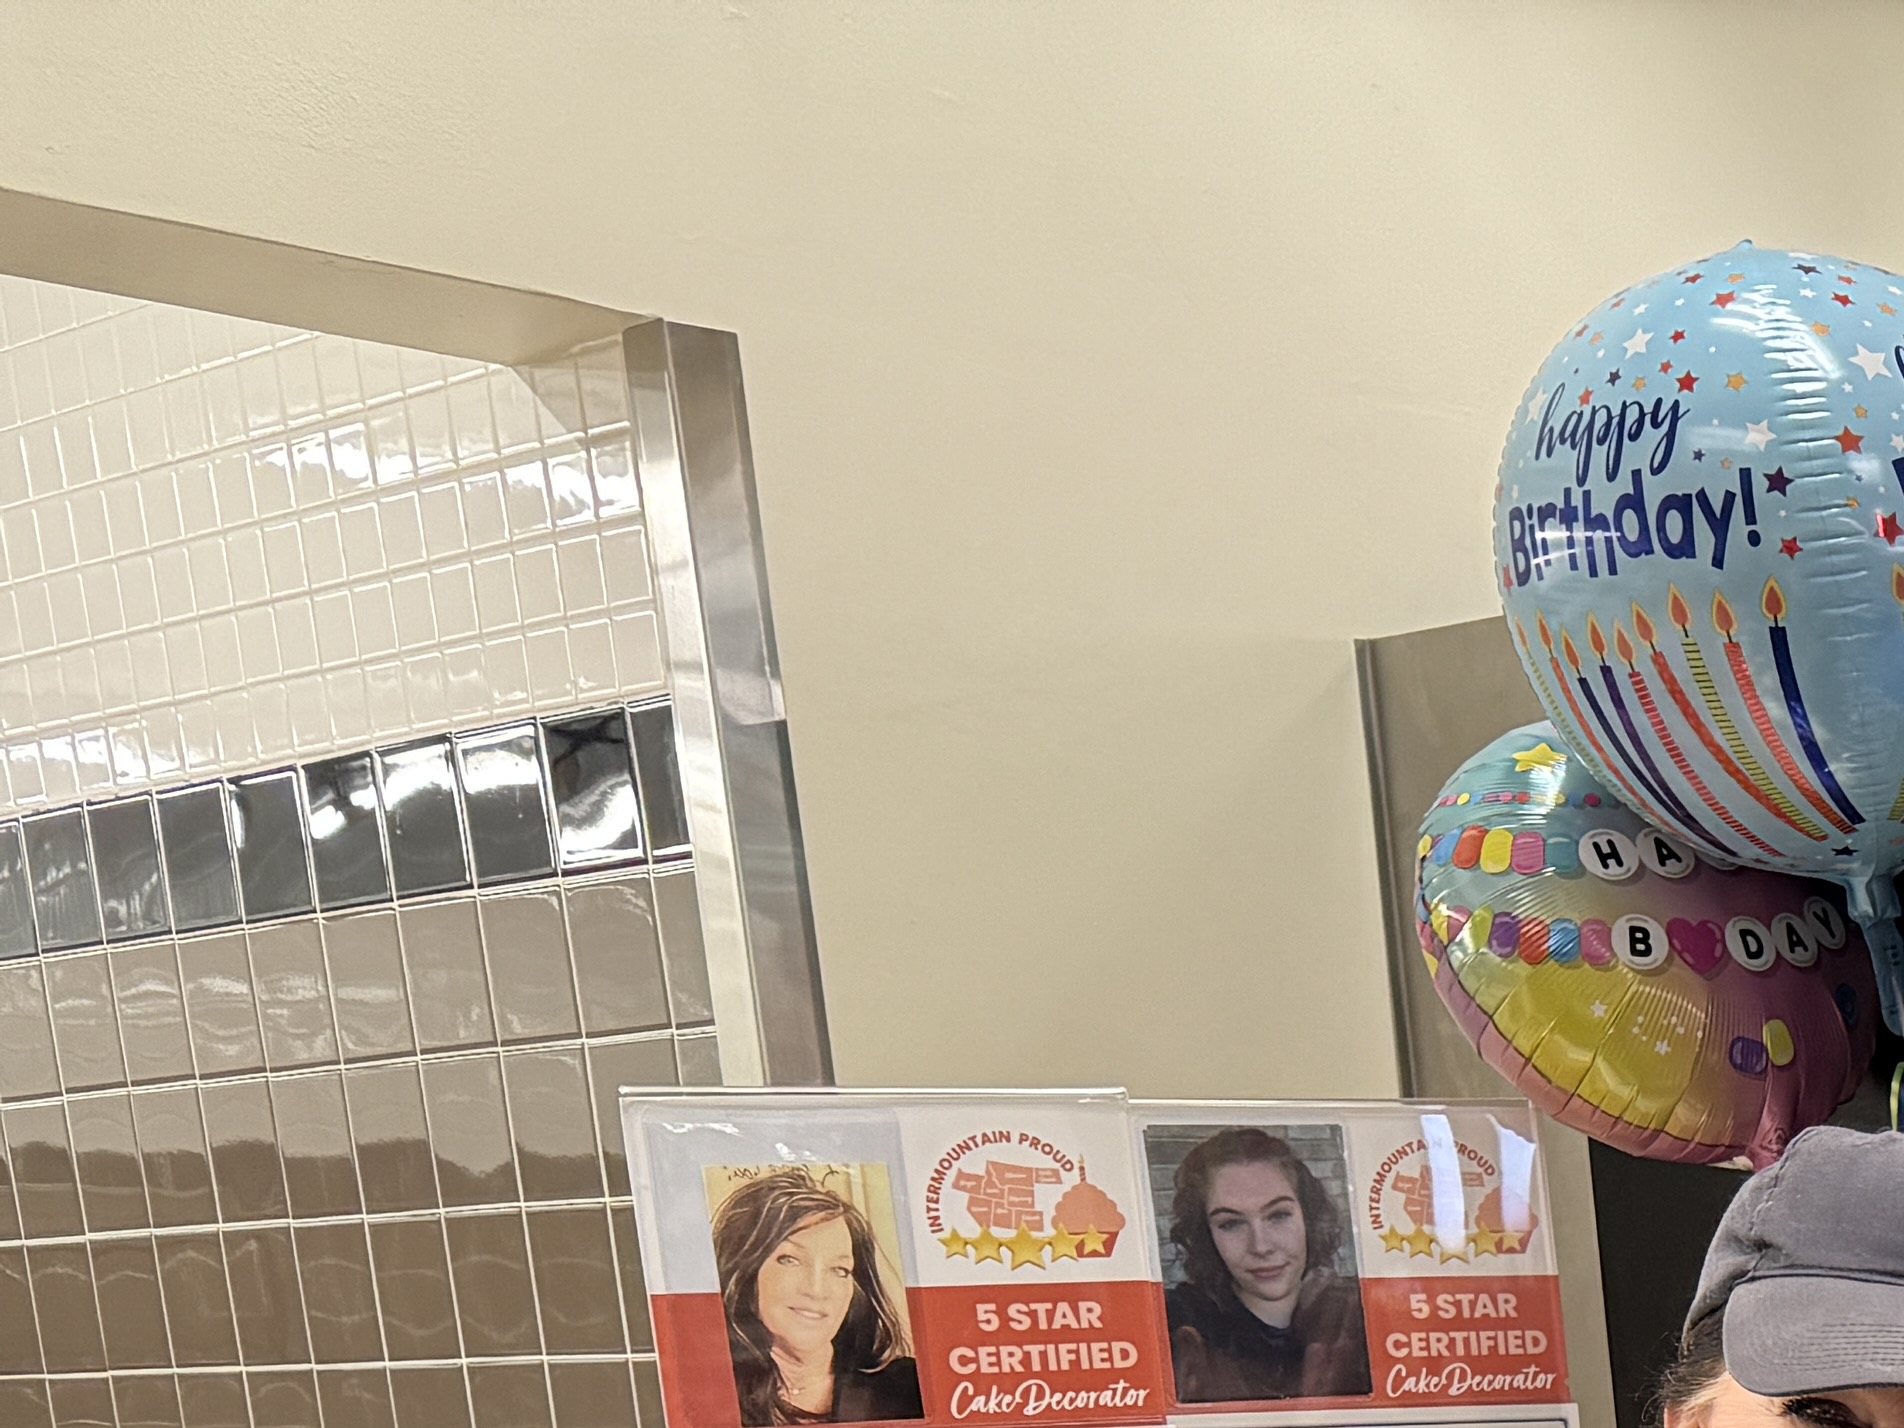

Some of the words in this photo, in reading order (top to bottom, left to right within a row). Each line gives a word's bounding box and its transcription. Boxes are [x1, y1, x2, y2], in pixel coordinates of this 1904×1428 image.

[1535, 382, 1690, 486] happy
[1509, 467, 1762, 588] Birthday!
[926, 1130, 1012, 1234] INTERMOUNTAIN
[1018, 1132, 1075, 1173] PROUD
[975, 1303, 1000, 1332] 5
[1006, 1301, 1103, 1331] STAR
[1408, 1293, 1431, 1320] 5
[1437, 1293, 1518, 1319] STAR
[948, 1341, 1138, 1375] CERTIFIED
[1385, 1329, 1548, 1358] CERTIFIED
